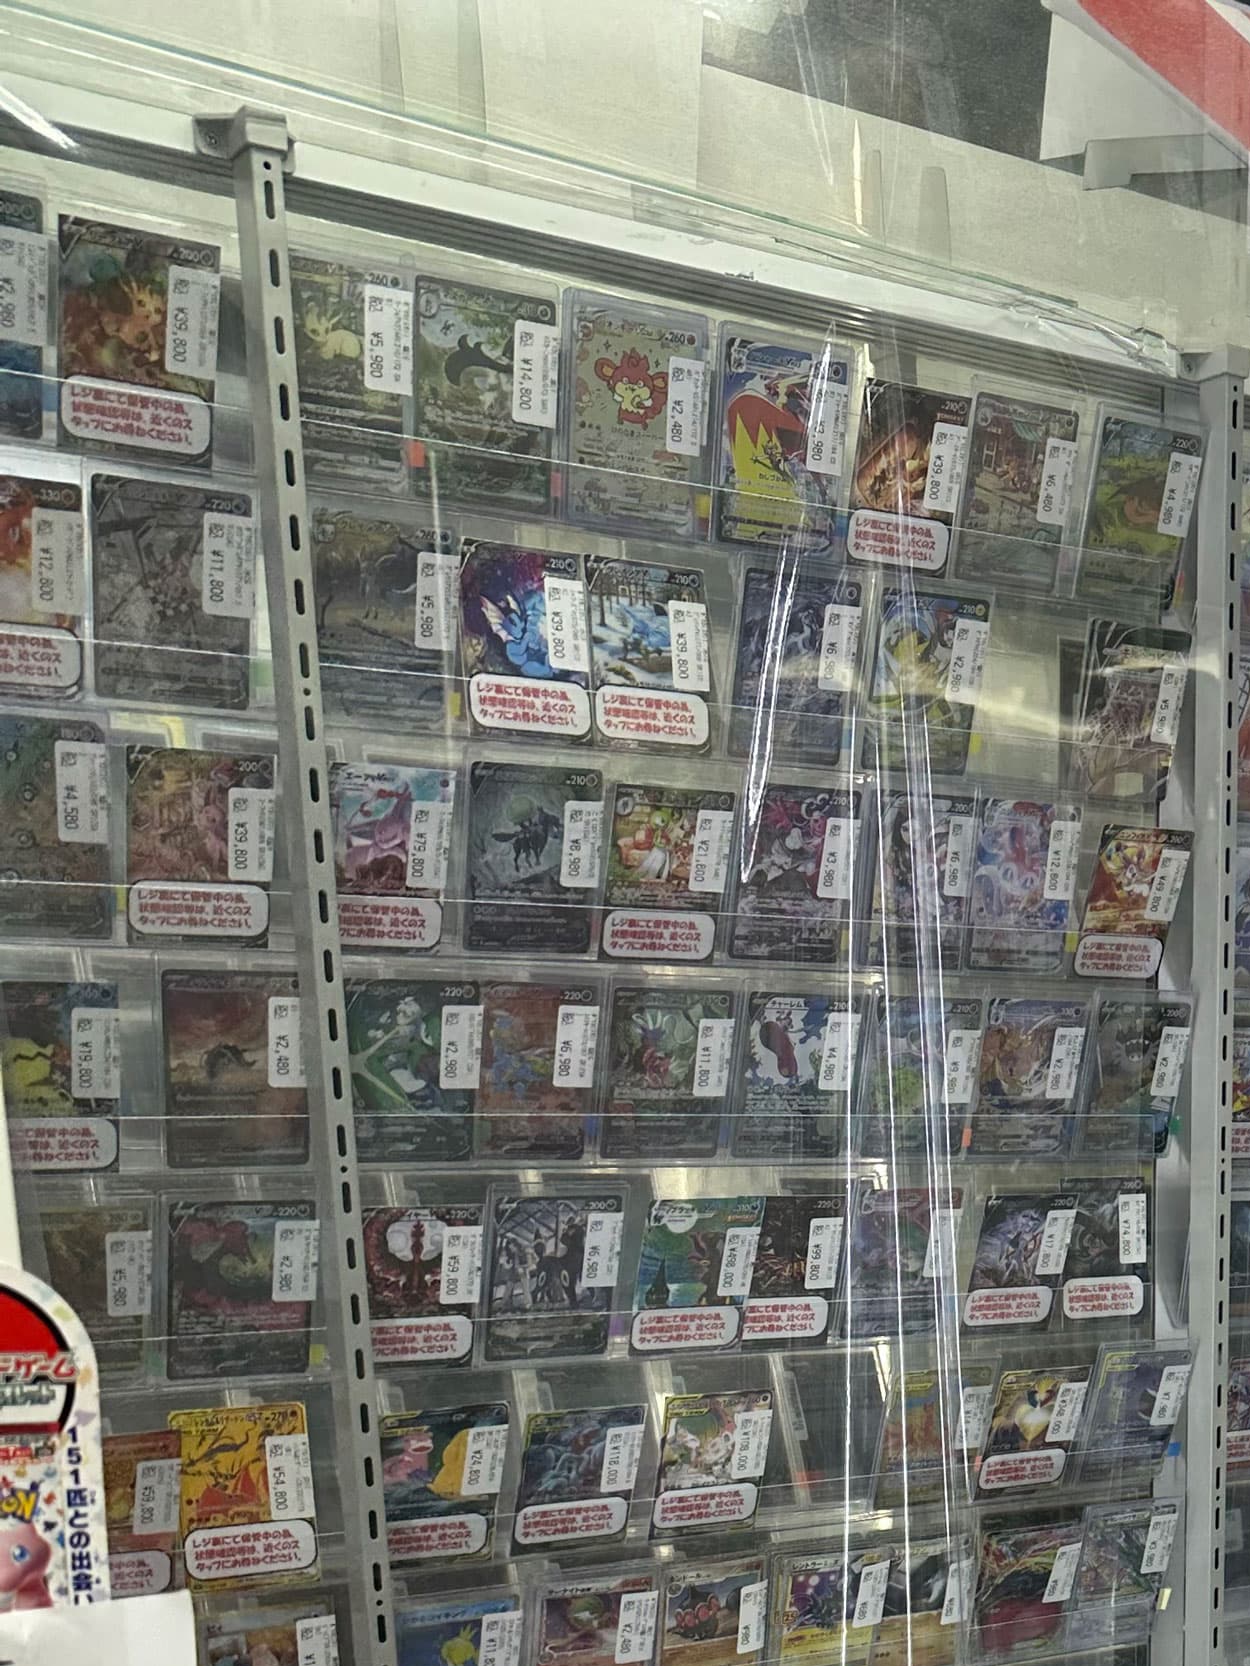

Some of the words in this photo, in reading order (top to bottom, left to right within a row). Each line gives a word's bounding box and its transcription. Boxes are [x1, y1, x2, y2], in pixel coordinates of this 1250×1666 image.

[173, 307, 190, 363] ¥39,800
[369, 331, 384, 379] ¥5,980
[518, 357, 535, 411] ¥14,800
[669, 399, 684, 444] ¥2,480
[927, 454, 945, 501] ¥39,800
[40, 548, 54, 602] ¥12,800
[210, 549, 225, 603] ¥11,800
[419, 593, 434, 639] ¥5,980
[551, 607, 566, 660] ¥39,800
[676, 631, 689, 680] ¥39,800
[950, 653, 965, 695] ¥2,980
[570, 775, 587, 787] 210
[233, 822, 249, 870] ¥39,800
[410, 831, 428, 879] ¥79,800
[567, 838, 581, 878] ¥8,980
[563, 989, 582, 1002] 220
[275, 1033, 290, 1076] ¥2,480
[557, 1039, 573, 1079] ¥6,980
[697, 1045, 713, 1088] ¥11,800
[274, 1464, 289, 1513] ¥54,800
